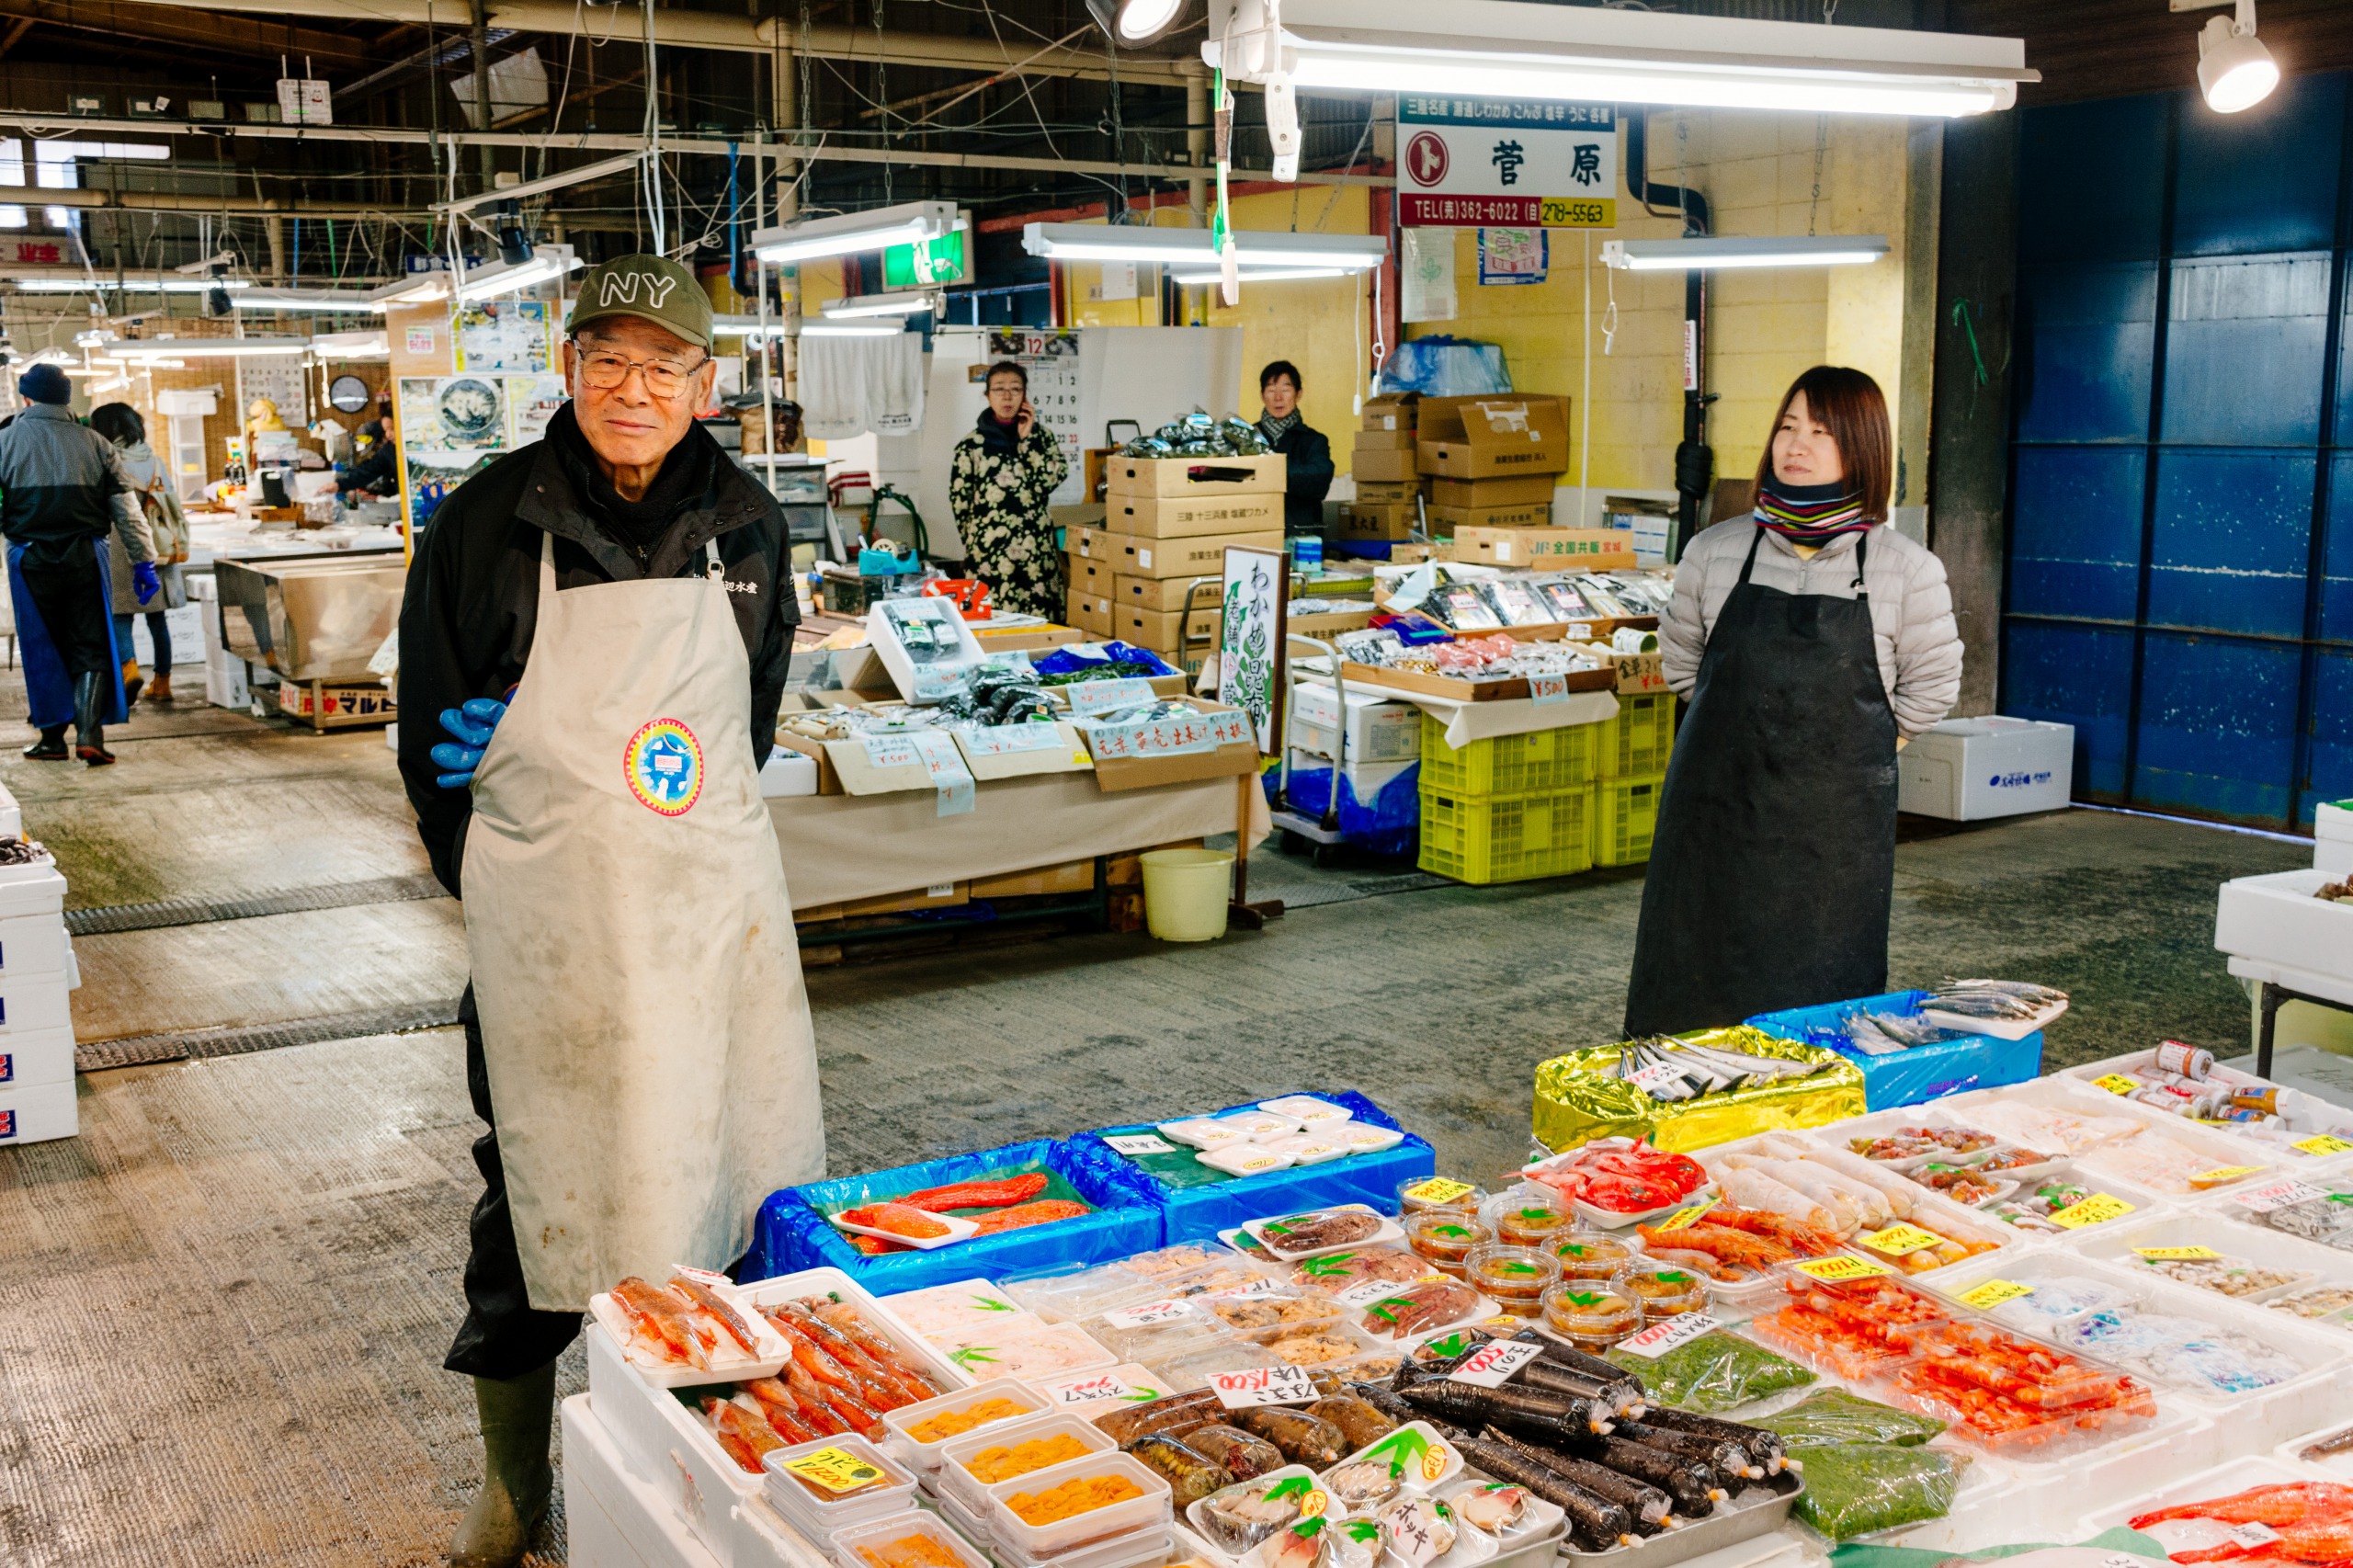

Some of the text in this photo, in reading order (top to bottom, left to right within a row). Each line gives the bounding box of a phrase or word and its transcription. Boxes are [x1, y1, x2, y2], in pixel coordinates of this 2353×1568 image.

[1492, 140, 1601, 187] 菅原
[599, 272, 676, 308] NY
[1027, 338, 1042, 354] 12
[1071, 377, 1076, 385] 2
[1033, 395, 1076, 404] 6 7 8 9
[1045, 415, 1077, 424] 14 15 16
[1177, 506, 1269, 522] 三陸 十三浜産 塩蔵ワカメ
[1553, 540, 1599, 554] 全国共販
[722, 580, 758, 594] 辺水産
[1532, 679, 1564, 697] ¥500
[1252, 1383, 1313, 1403] なまこ
[1395, 1502, 1429, 1556] ホッキ
